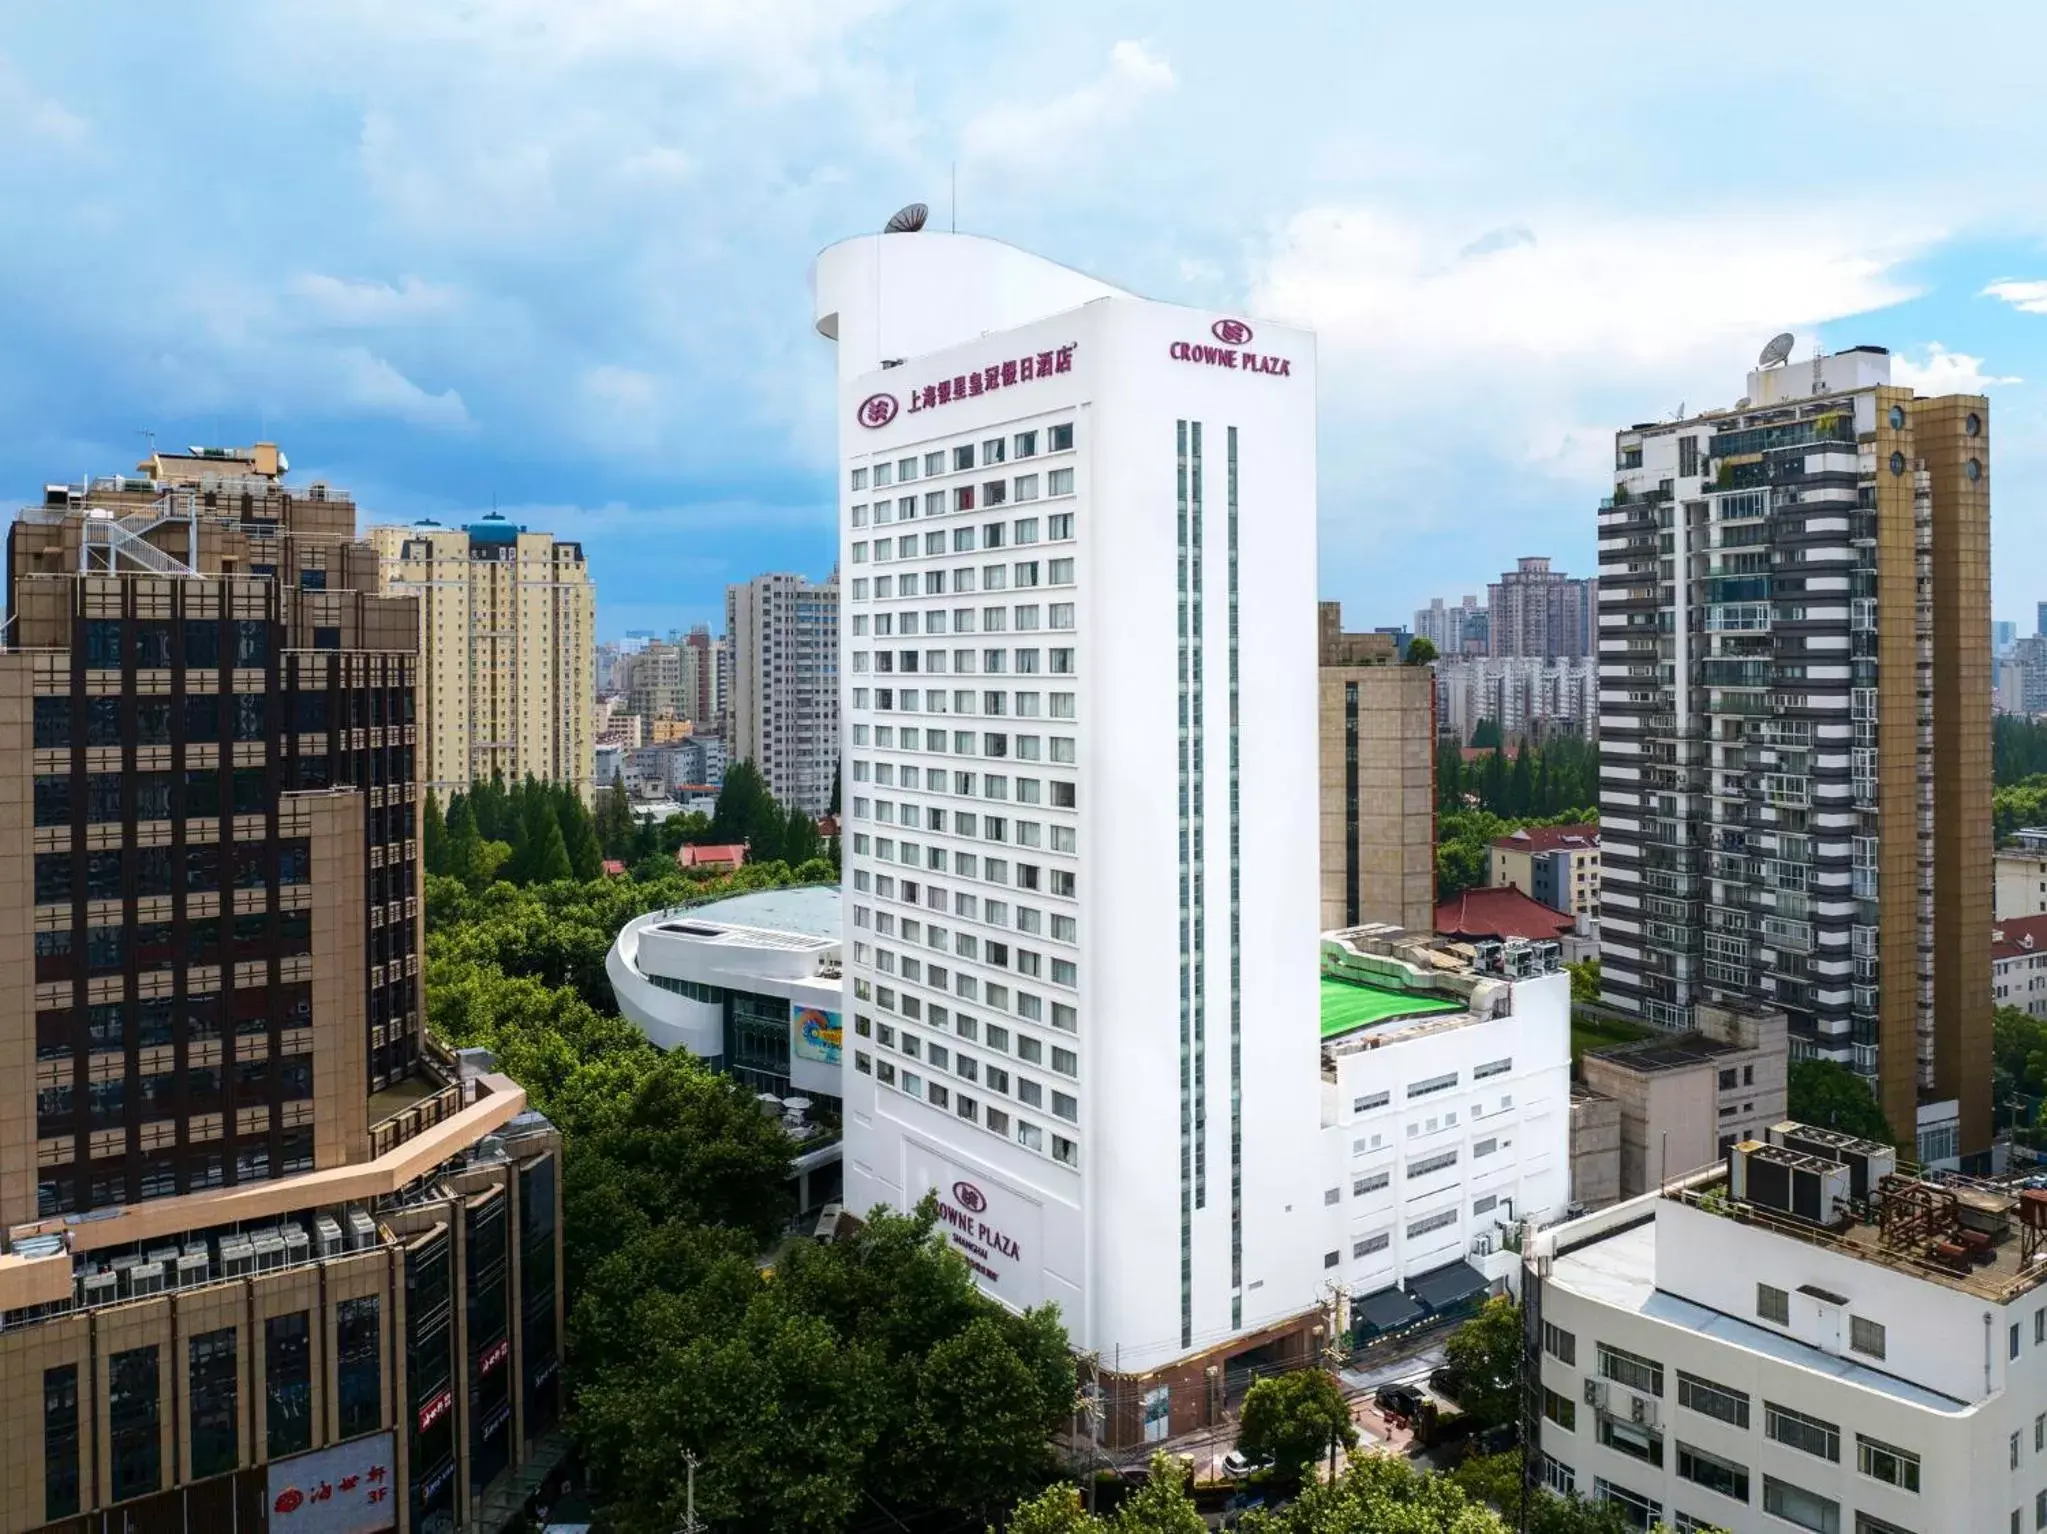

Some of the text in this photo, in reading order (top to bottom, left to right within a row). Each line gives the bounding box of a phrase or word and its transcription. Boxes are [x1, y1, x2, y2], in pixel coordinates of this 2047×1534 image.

[1170, 341, 1291, 377] CROWNE PLAZA
[938, 1202, 1020, 1262] OWNE PLAZA
